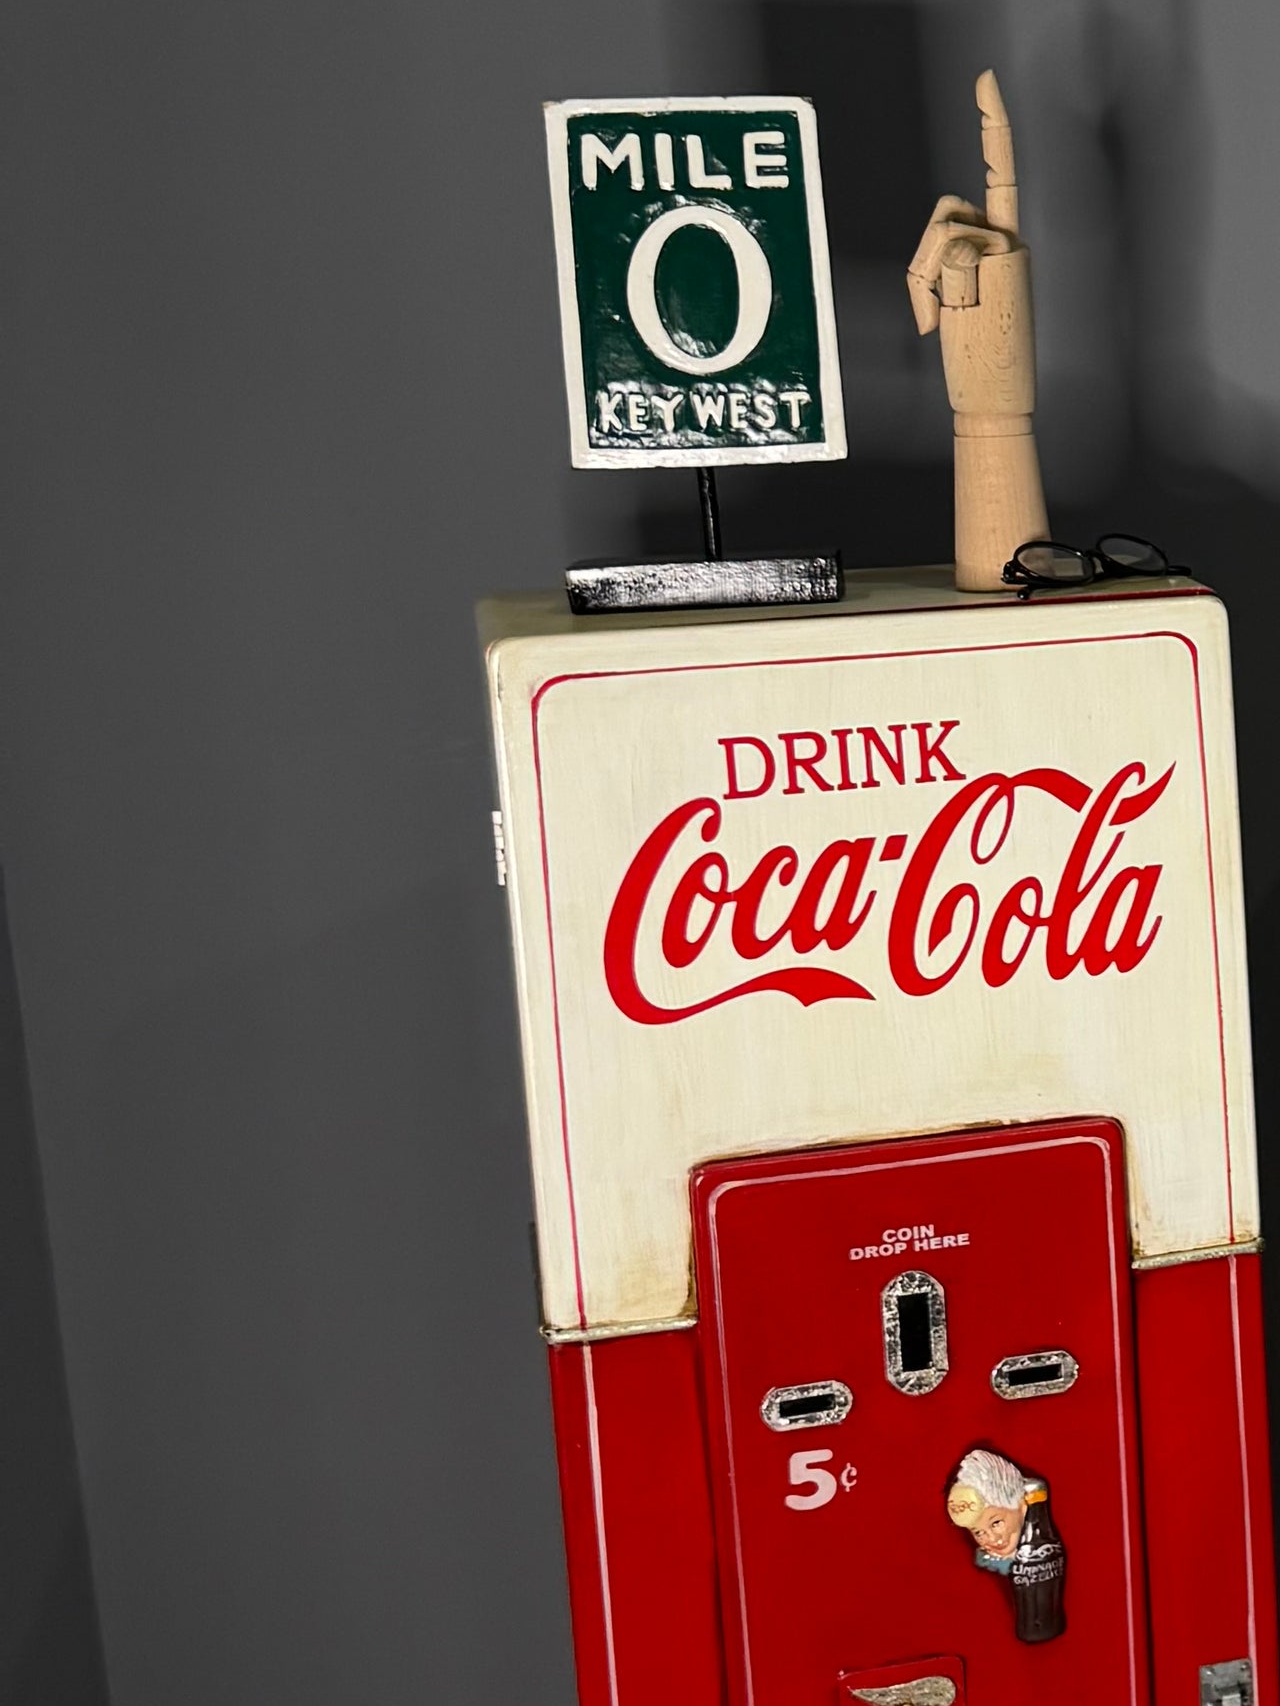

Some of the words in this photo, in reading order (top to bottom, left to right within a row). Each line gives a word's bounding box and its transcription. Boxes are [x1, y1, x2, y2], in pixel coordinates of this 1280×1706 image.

[580, 130, 790, 191] MILE
[600, 392, 684, 433] KEY
[692, 391, 811, 431] WEST
[717, 720, 967, 800] DRINK
[603, 761, 1176, 1026] Coca-Cola
[849, 1239, 907, 1260] DROP
[913, 1232, 970, 1252] HERE
[881, 1224, 935, 1244] COIN
